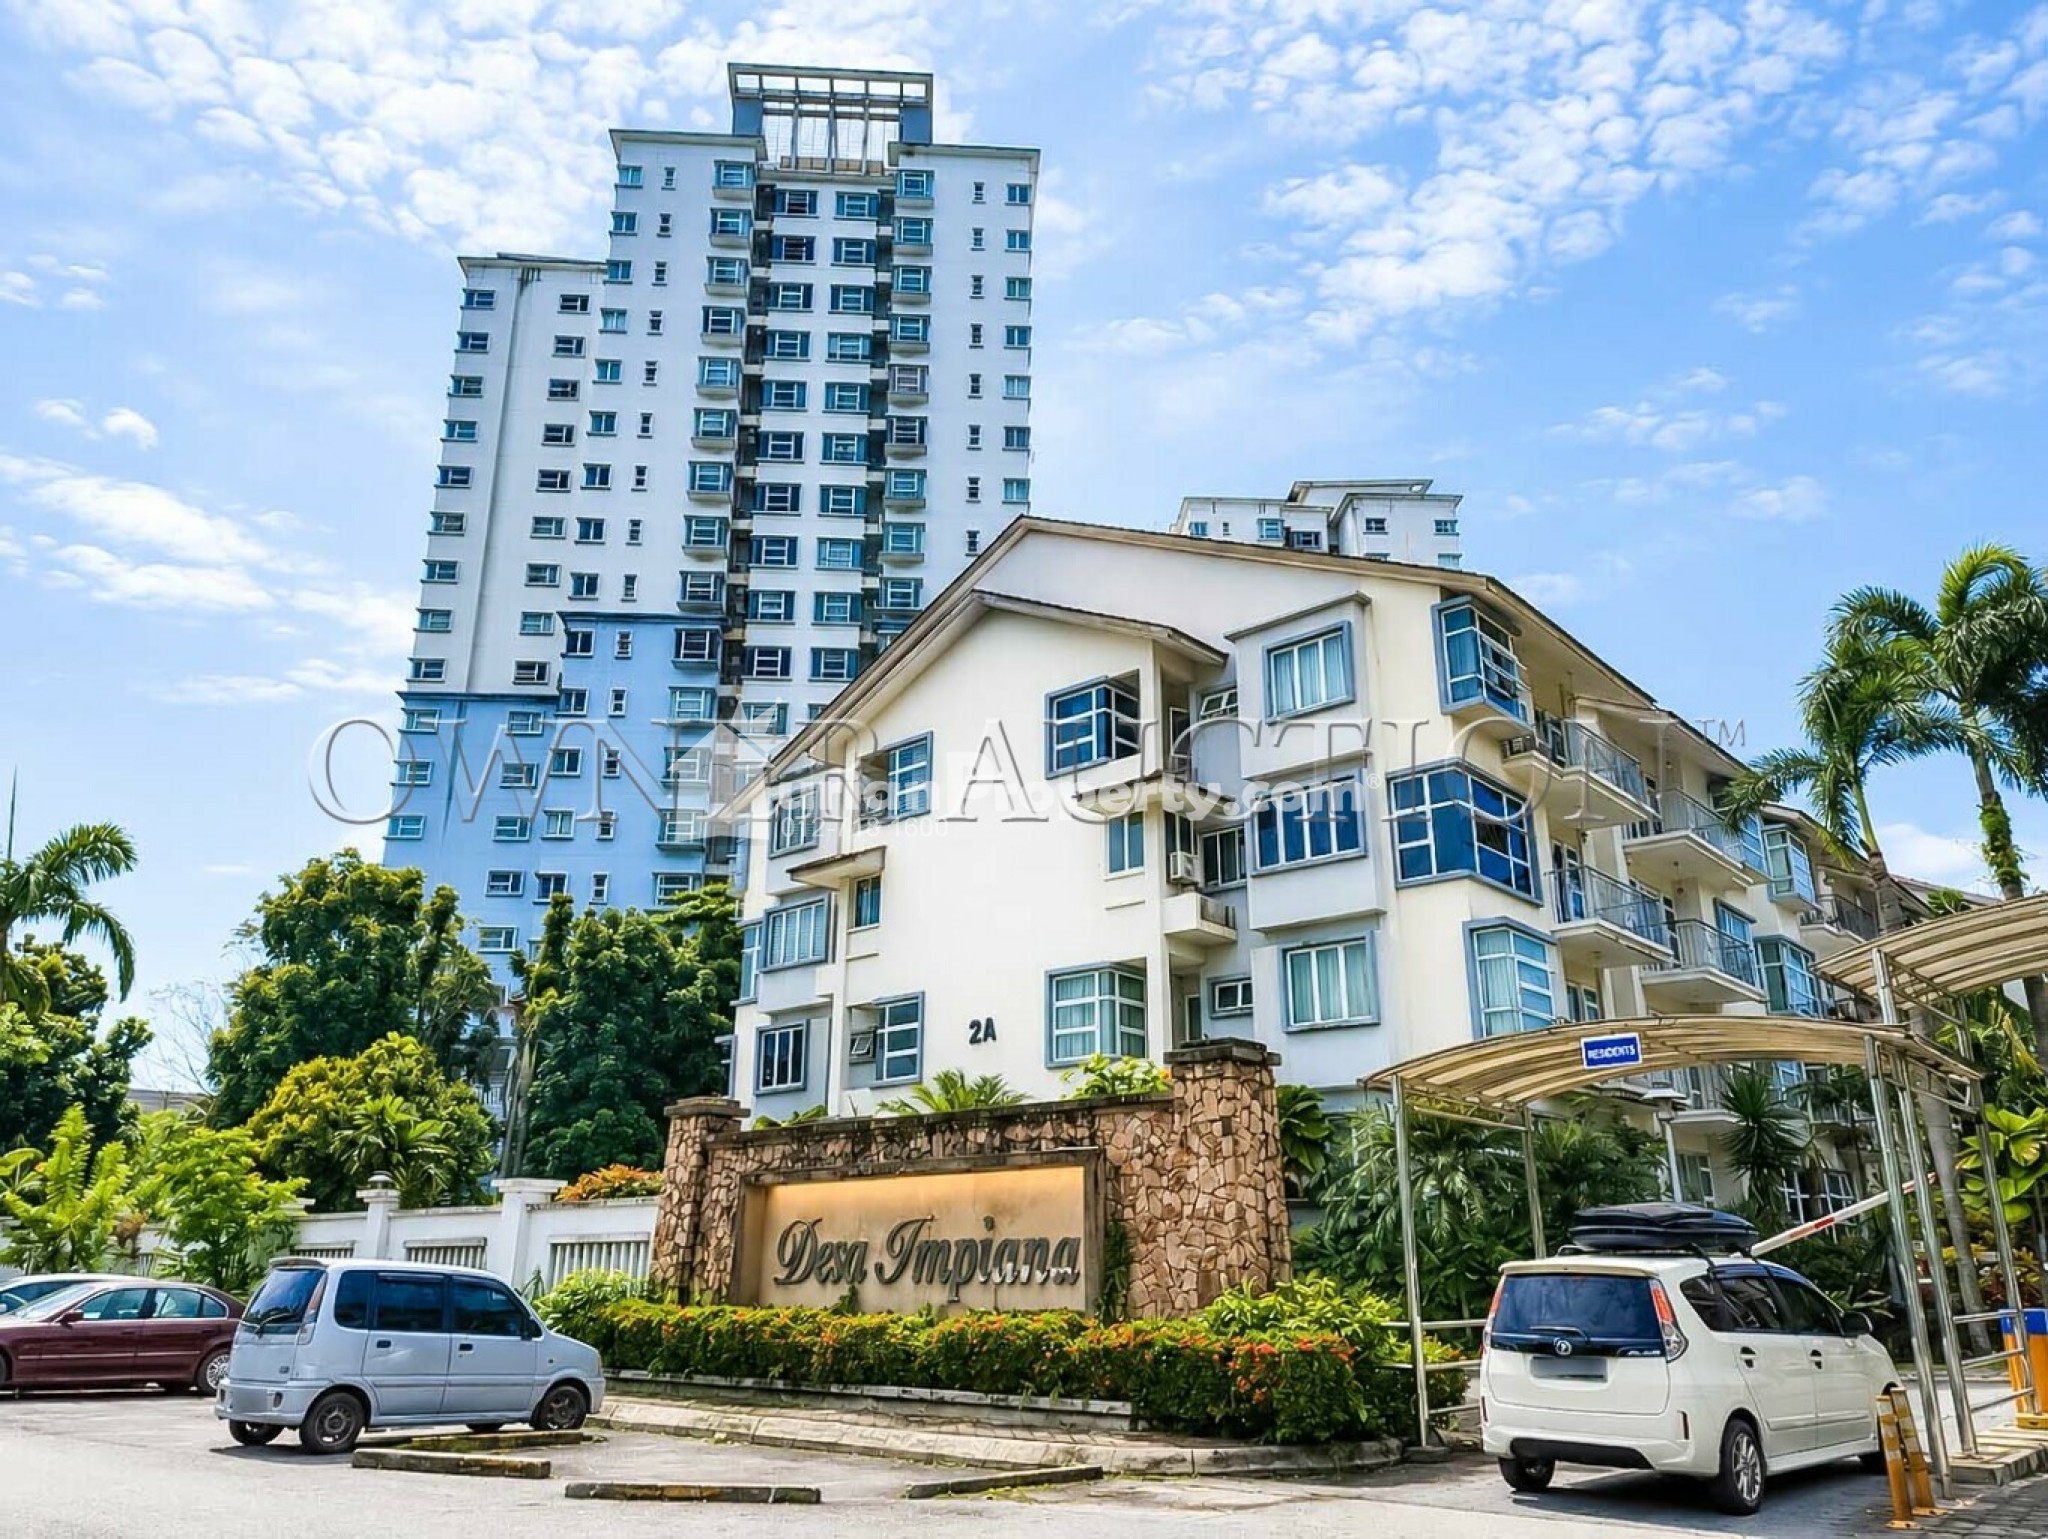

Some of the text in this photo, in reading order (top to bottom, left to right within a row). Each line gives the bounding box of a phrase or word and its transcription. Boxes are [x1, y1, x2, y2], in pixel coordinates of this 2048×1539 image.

[968, 1017, 997, 1045] 2A
[773, 1213, 1081, 1304] Desa Impiana
